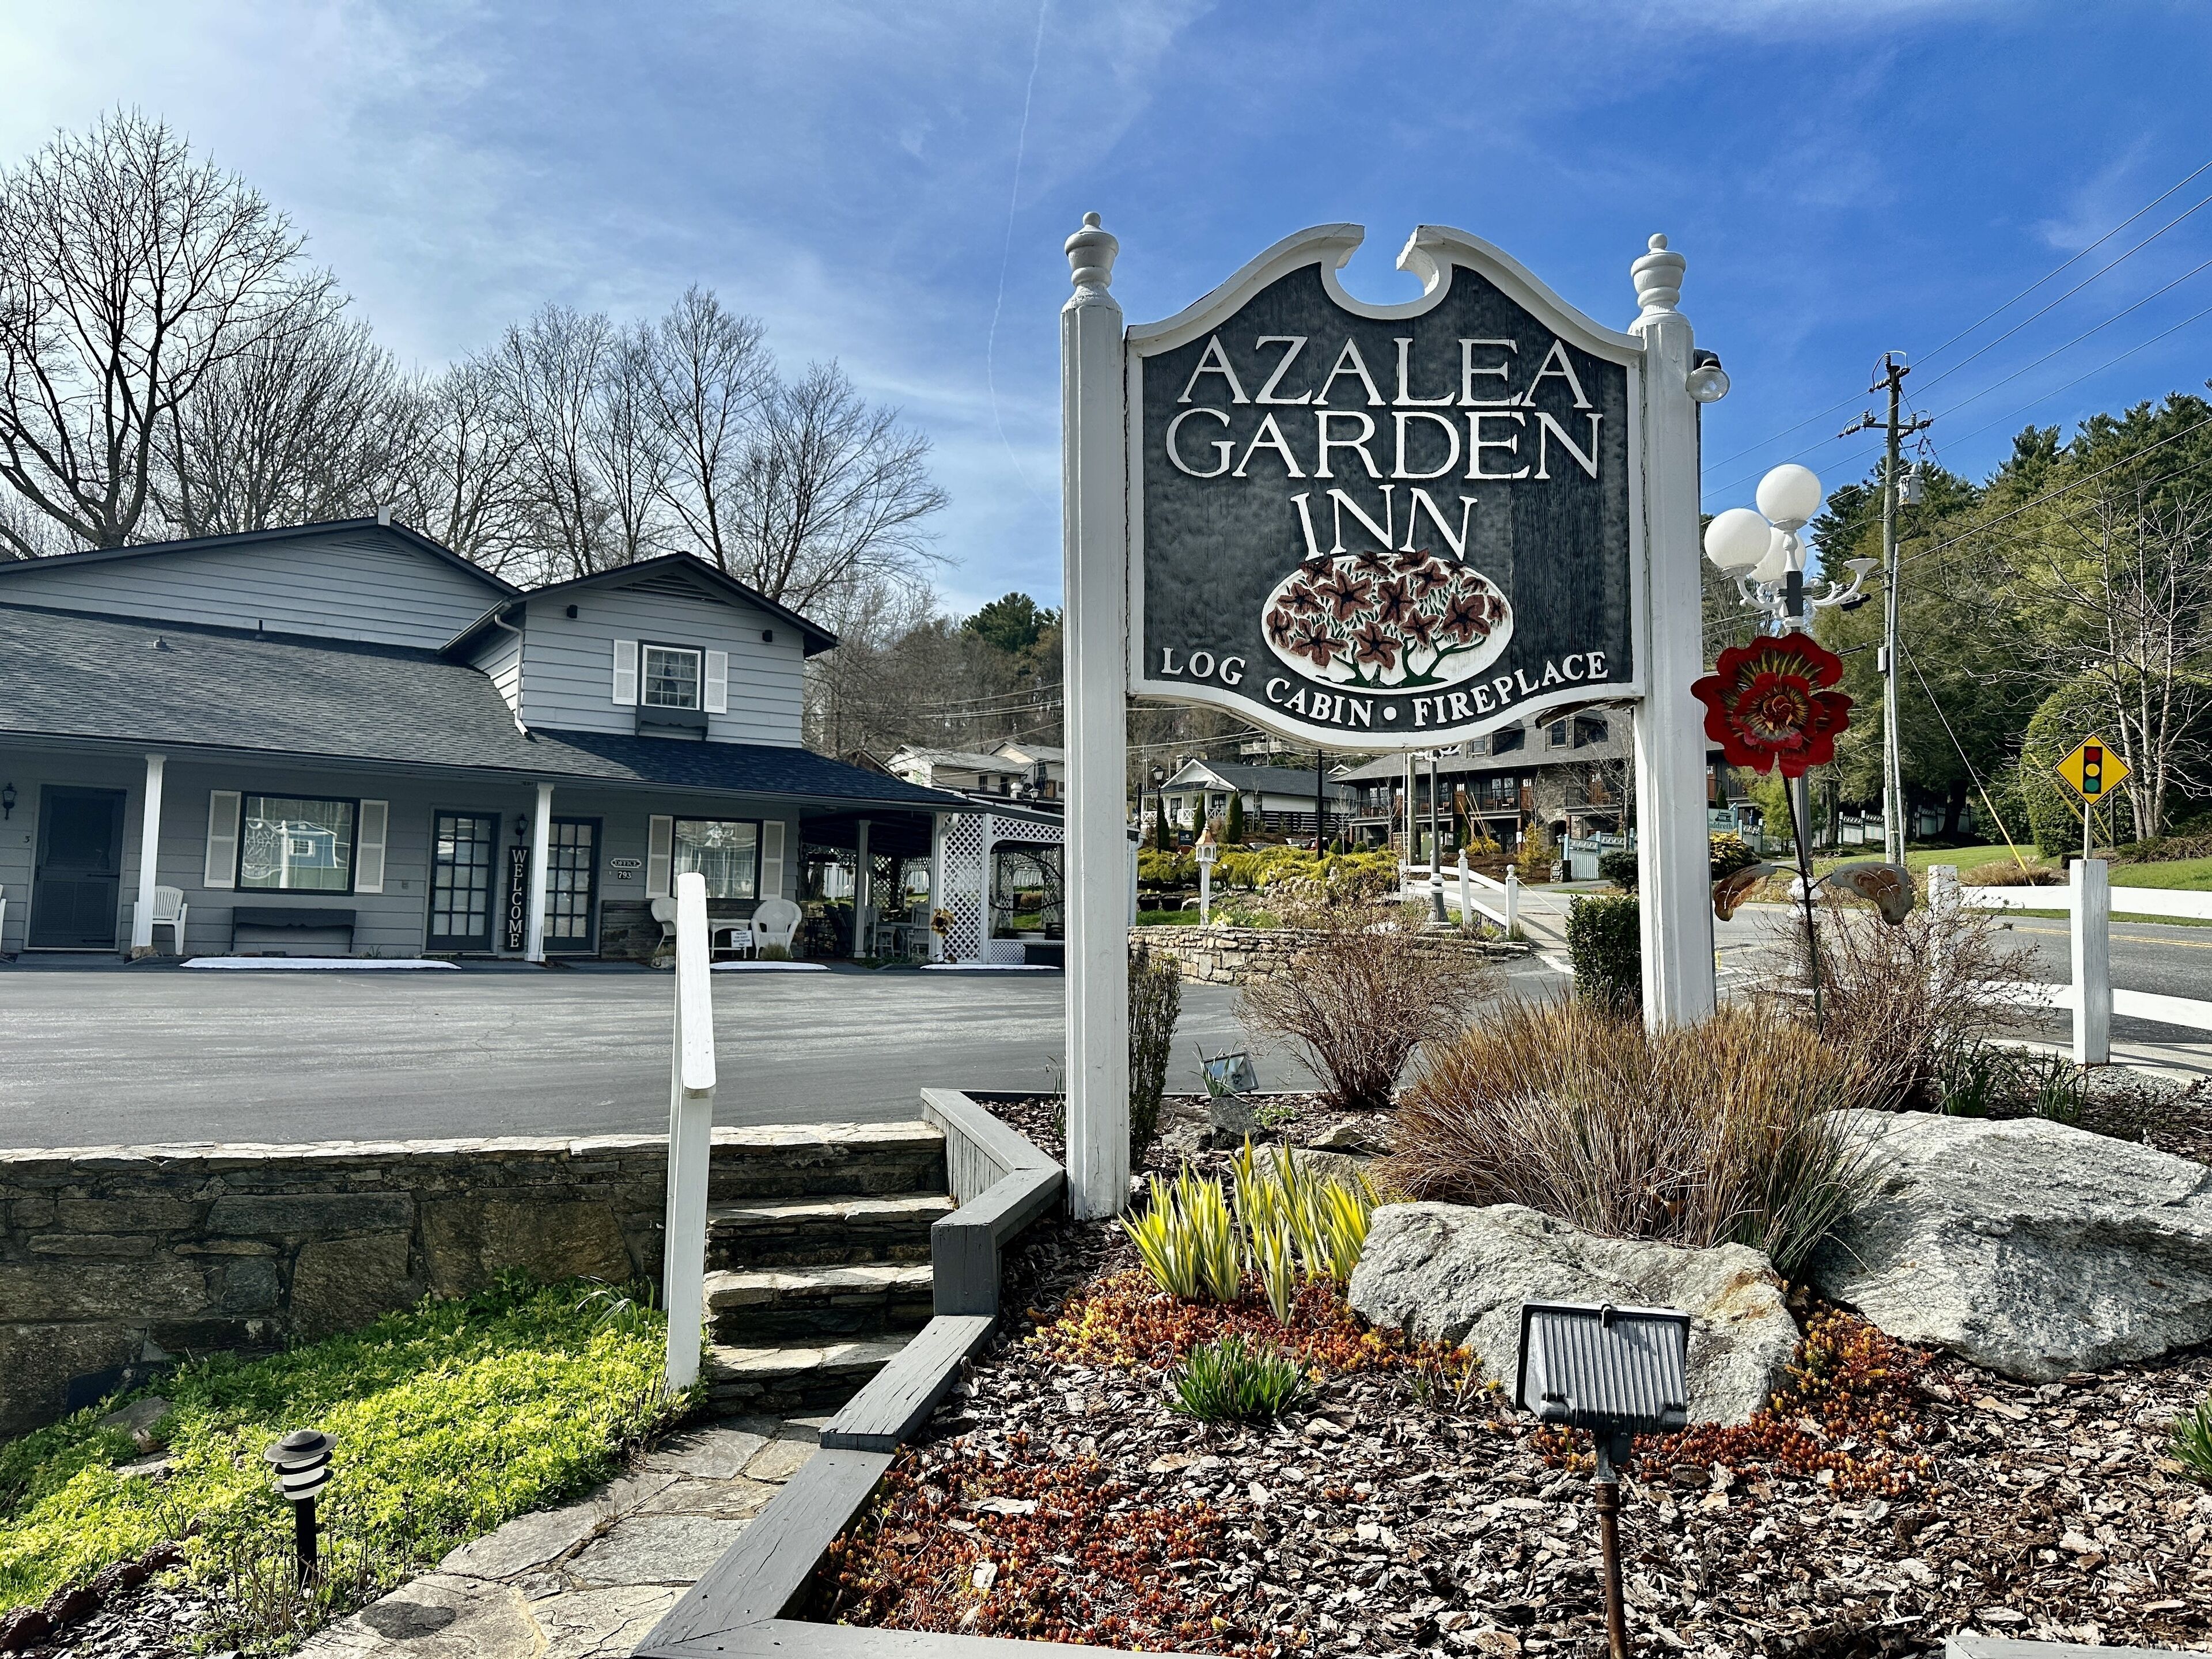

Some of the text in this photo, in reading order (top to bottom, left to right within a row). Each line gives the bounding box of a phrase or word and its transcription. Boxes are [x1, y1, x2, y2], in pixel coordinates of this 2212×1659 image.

[1176, 334, 1593, 409] AZALEA
[1165, 407, 1603, 480] GARDEN
[1290, 484, 1479, 562] INN
[1161, 647, 1609, 728] LOG CABIN FIREPLACE
[23, 835, 31, 843] 3
[1709, 821, 1733, 830] uddreth
[508, 849, 528, 948] WELCOME
[618, 871, 632, 879] 793
